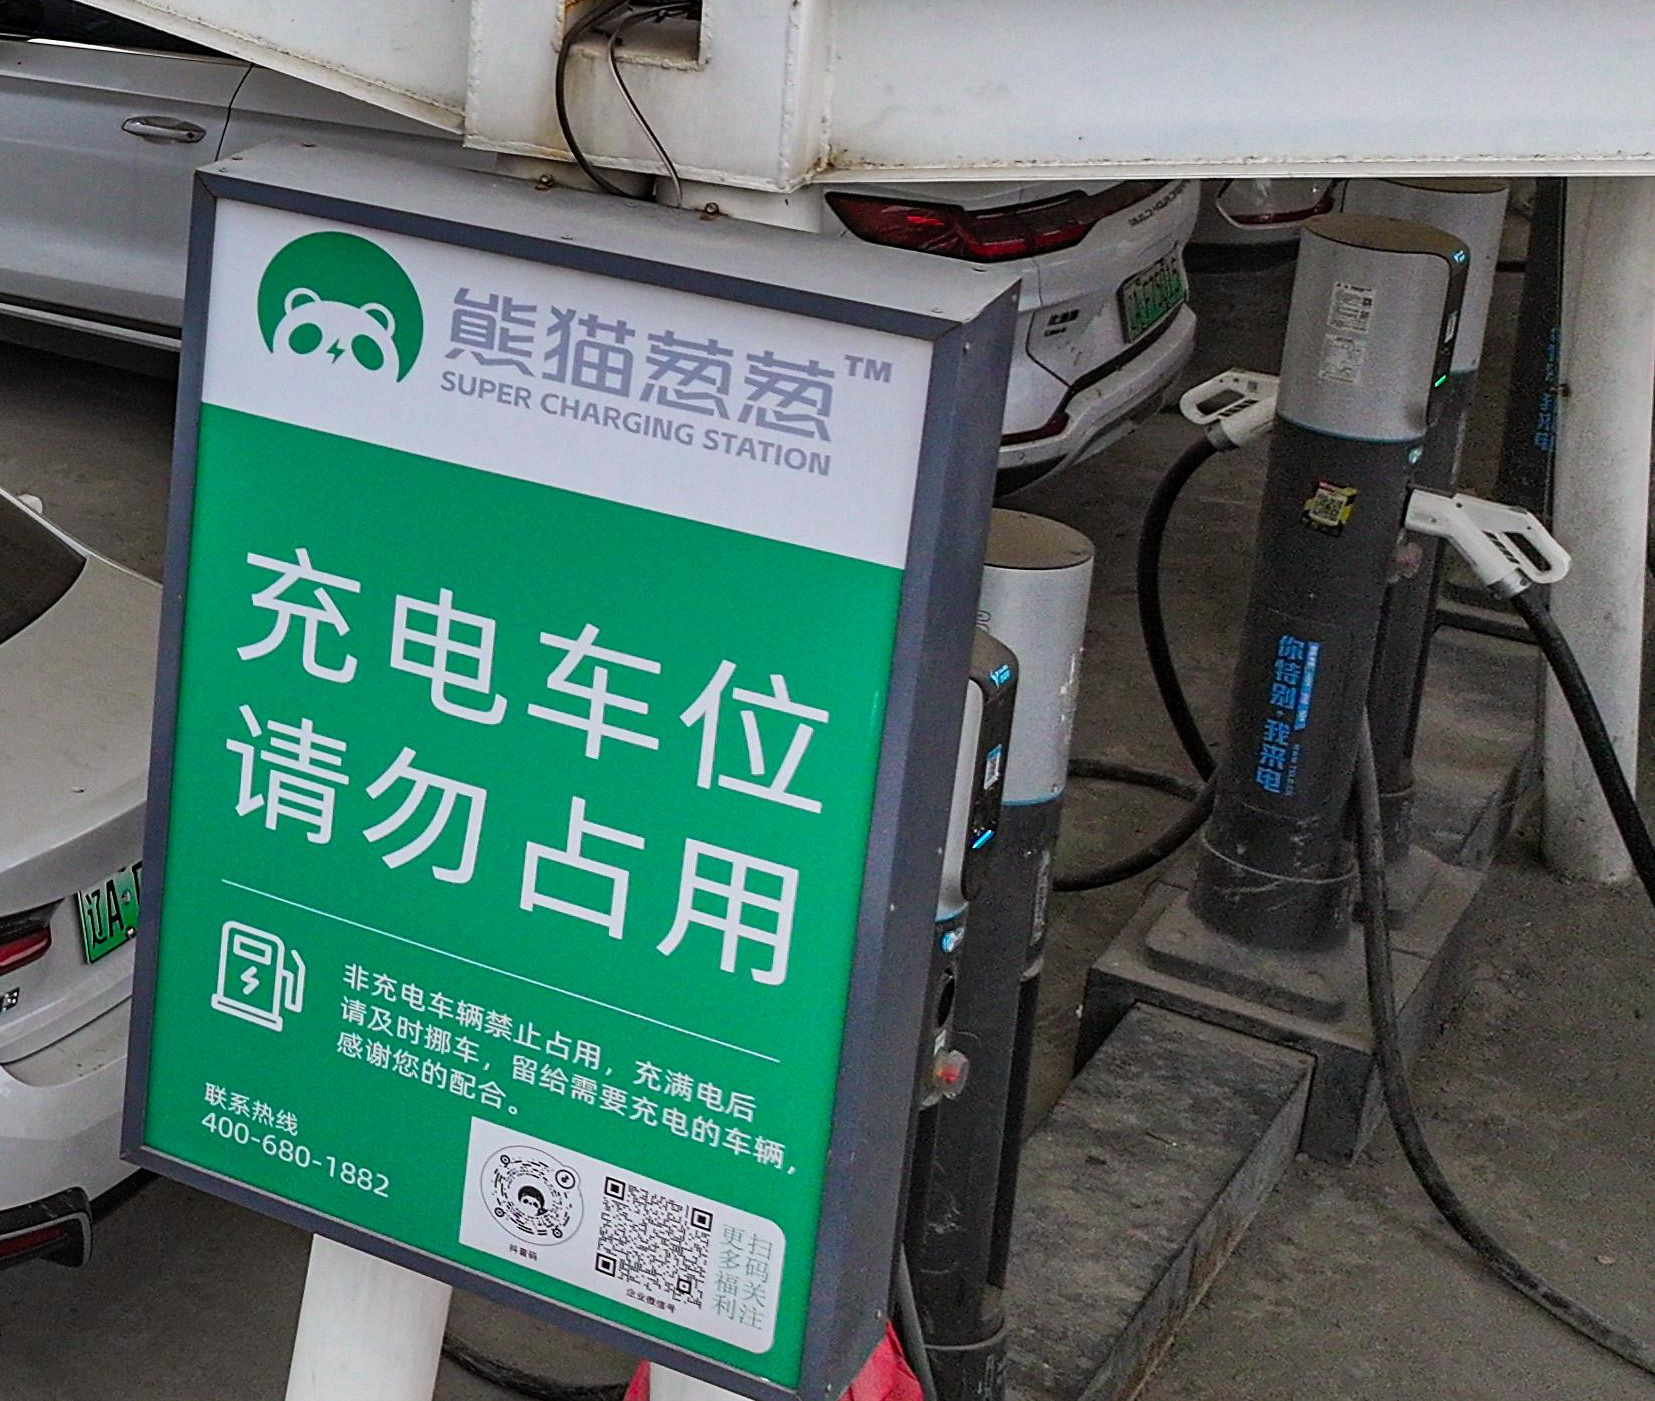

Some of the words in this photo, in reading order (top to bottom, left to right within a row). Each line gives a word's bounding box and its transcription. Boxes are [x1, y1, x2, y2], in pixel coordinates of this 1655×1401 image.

[444, 286, 835, 442] 熊猫葱葱
[440, 370, 532, 410] SUPER
[540, 392, 694, 447] CHARGING
[702, 429, 832, 477] STATION
[236, 546, 830, 815] 充电车位
[225, 703, 800, 986] 请勿占用
[204, 1082, 299, 1136] 联系热线
[336, 1031, 522, 1116] 感谢您的配合。
[202, 1112, 390, 1199] 400-680-1882
